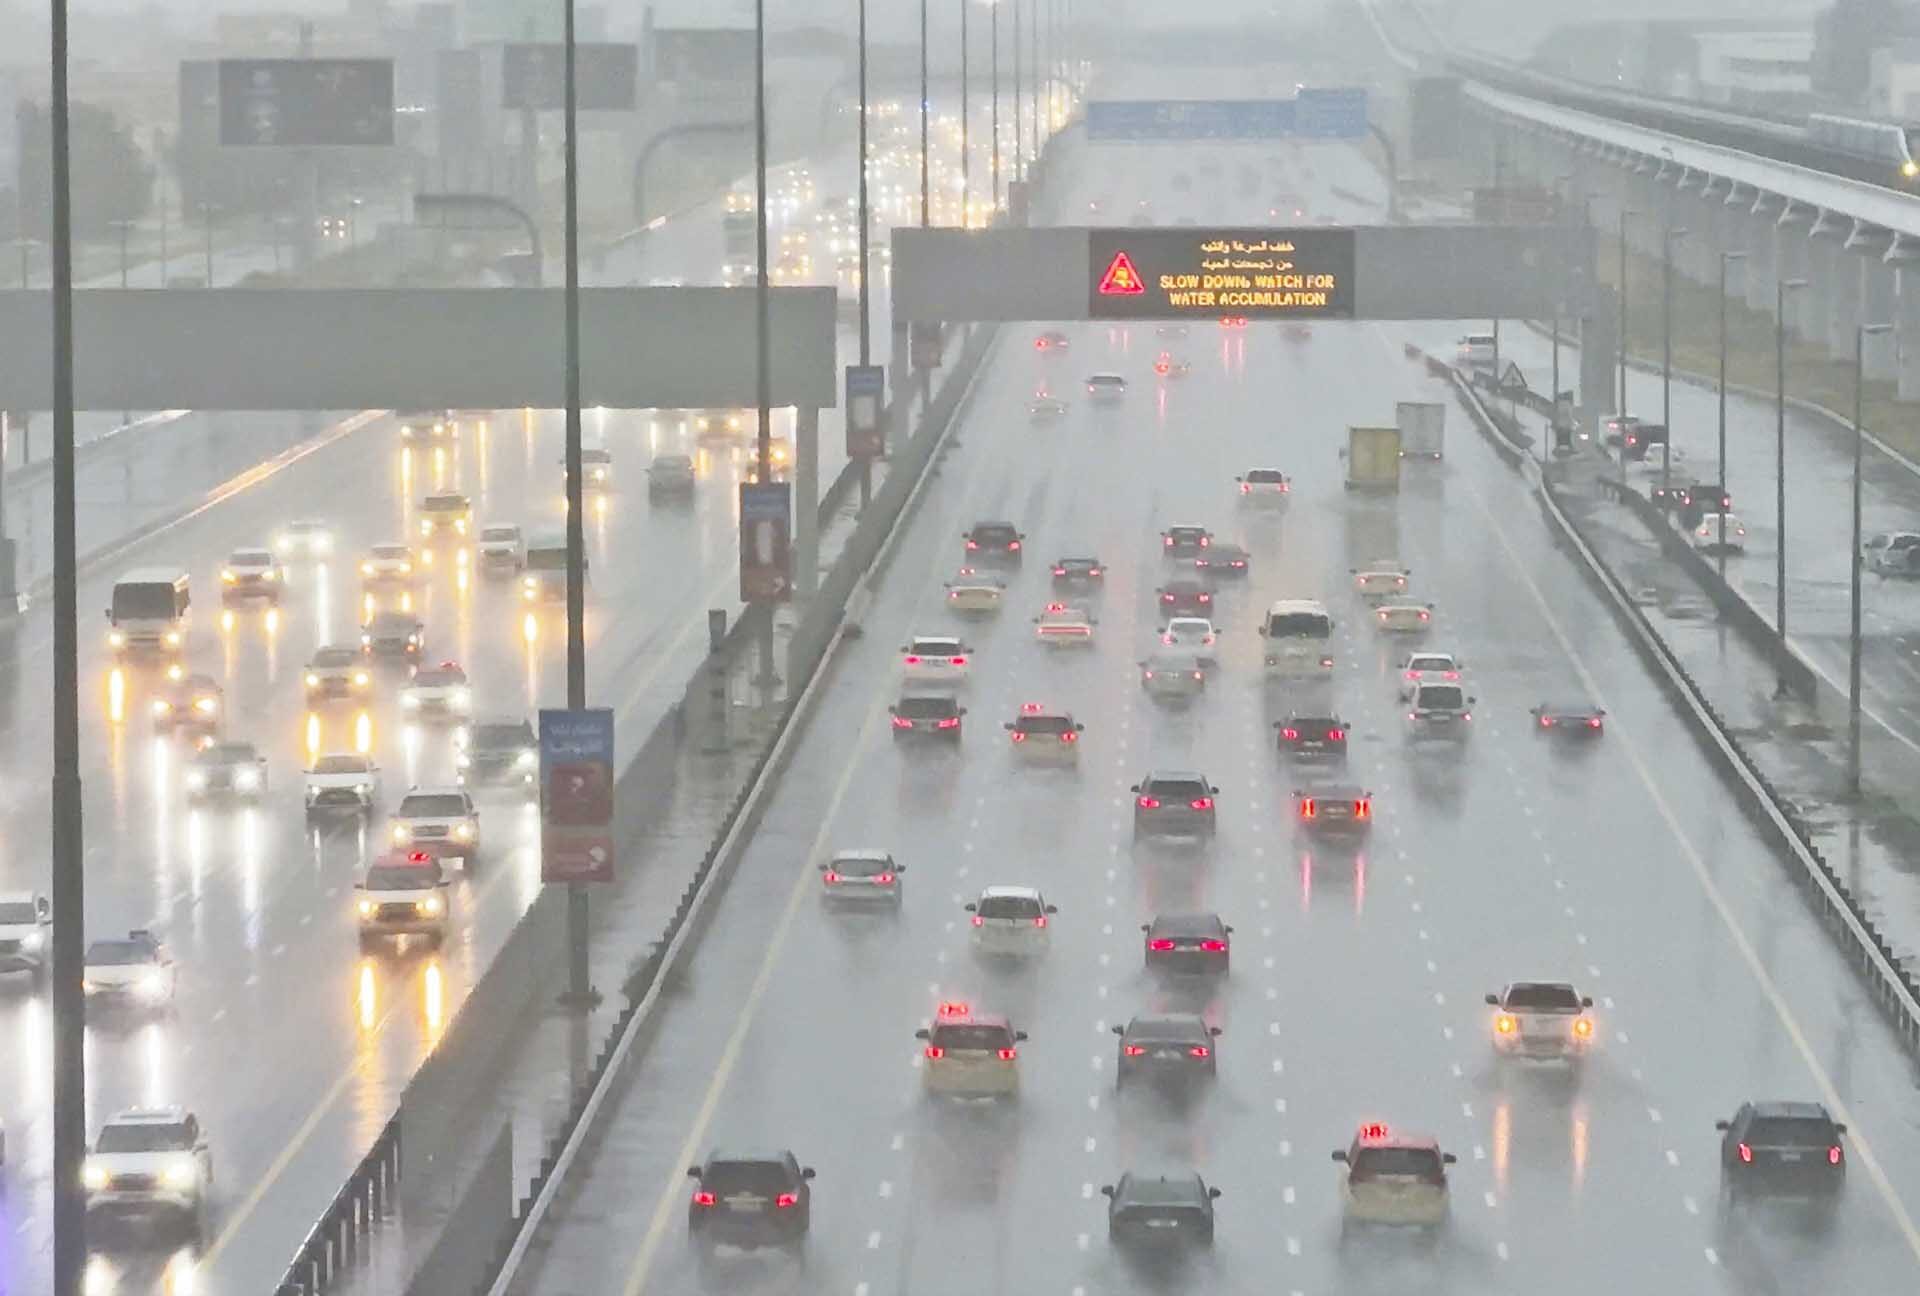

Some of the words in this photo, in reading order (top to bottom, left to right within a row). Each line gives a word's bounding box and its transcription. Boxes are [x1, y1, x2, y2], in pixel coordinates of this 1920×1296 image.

[1160, 275, 1200, 289] SLOW
[1255, 275, 1303, 289] WATCH
[1306, 275, 1335, 289] FOR
[1170, 292, 1215, 306] WATER
[1220, 292, 1326, 306] ACCUMULATION
